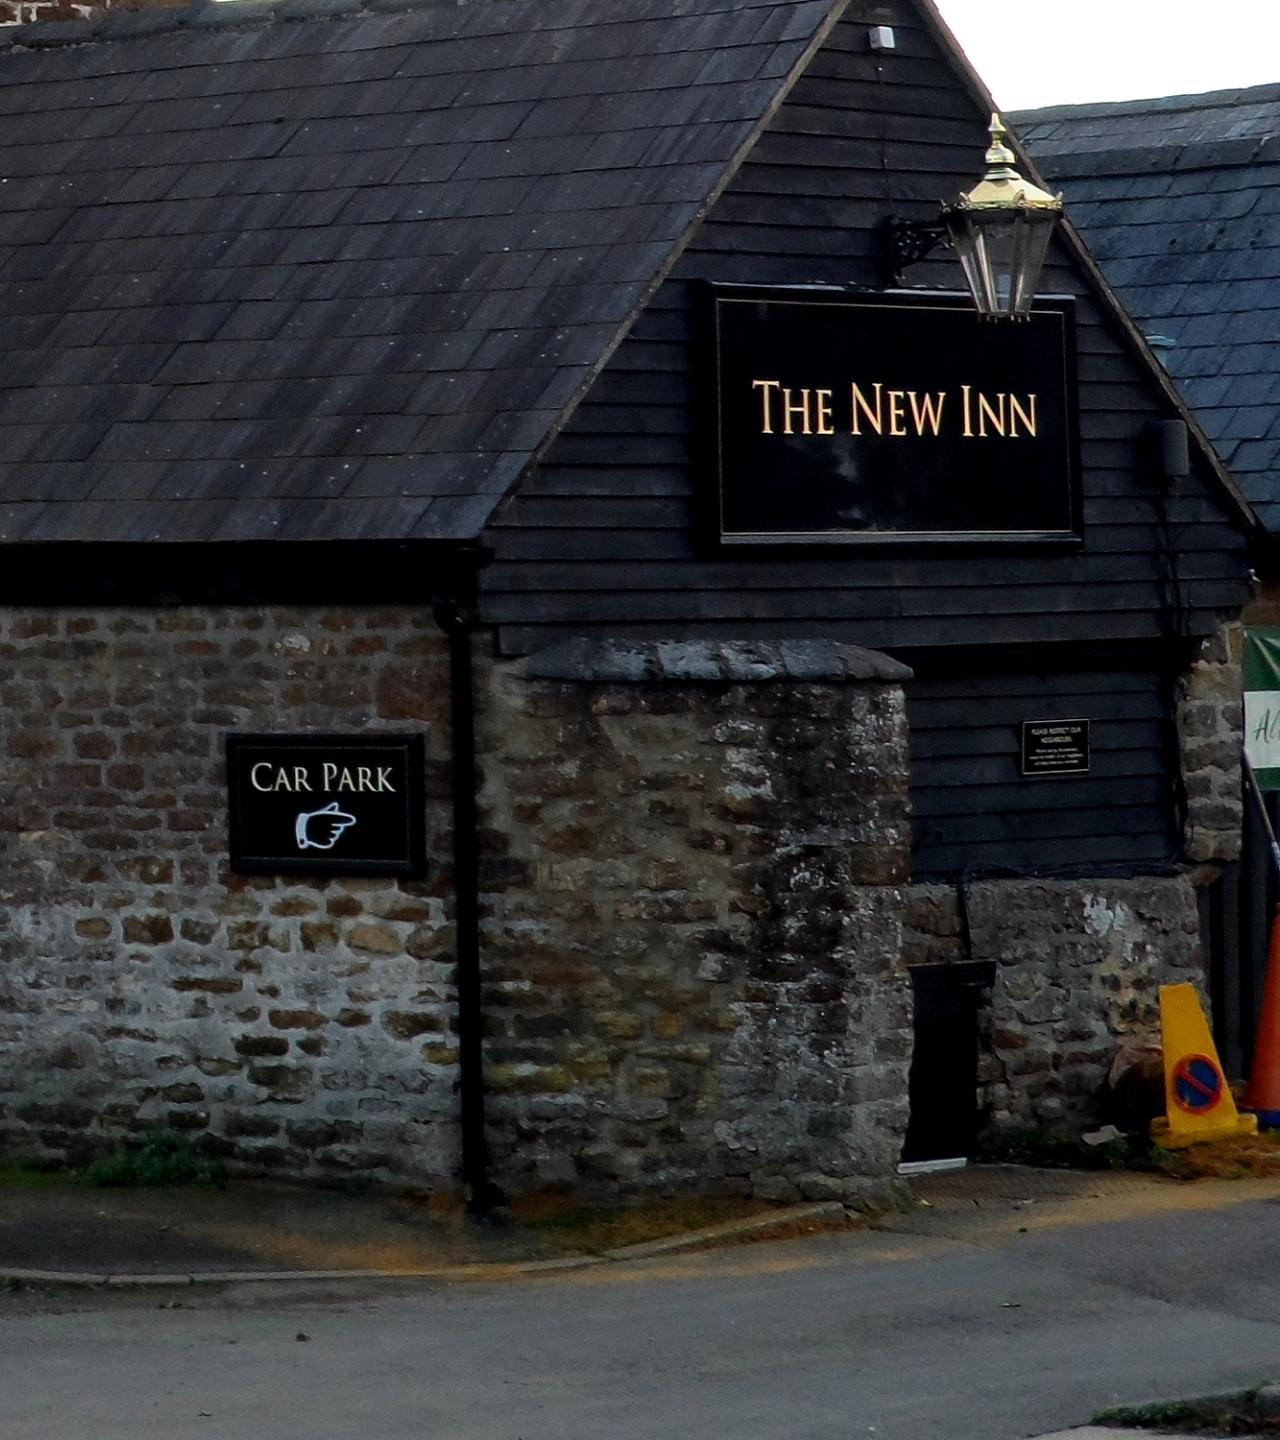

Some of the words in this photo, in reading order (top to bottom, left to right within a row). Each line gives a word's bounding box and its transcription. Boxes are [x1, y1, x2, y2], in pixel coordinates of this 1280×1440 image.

[752, 379, 835, 435] THE
[850, 381, 947, 437] NEW
[960, 385, 1038, 438] INN
[250, 762, 313, 793] CAR
[322, 762, 397, 793] PARK
